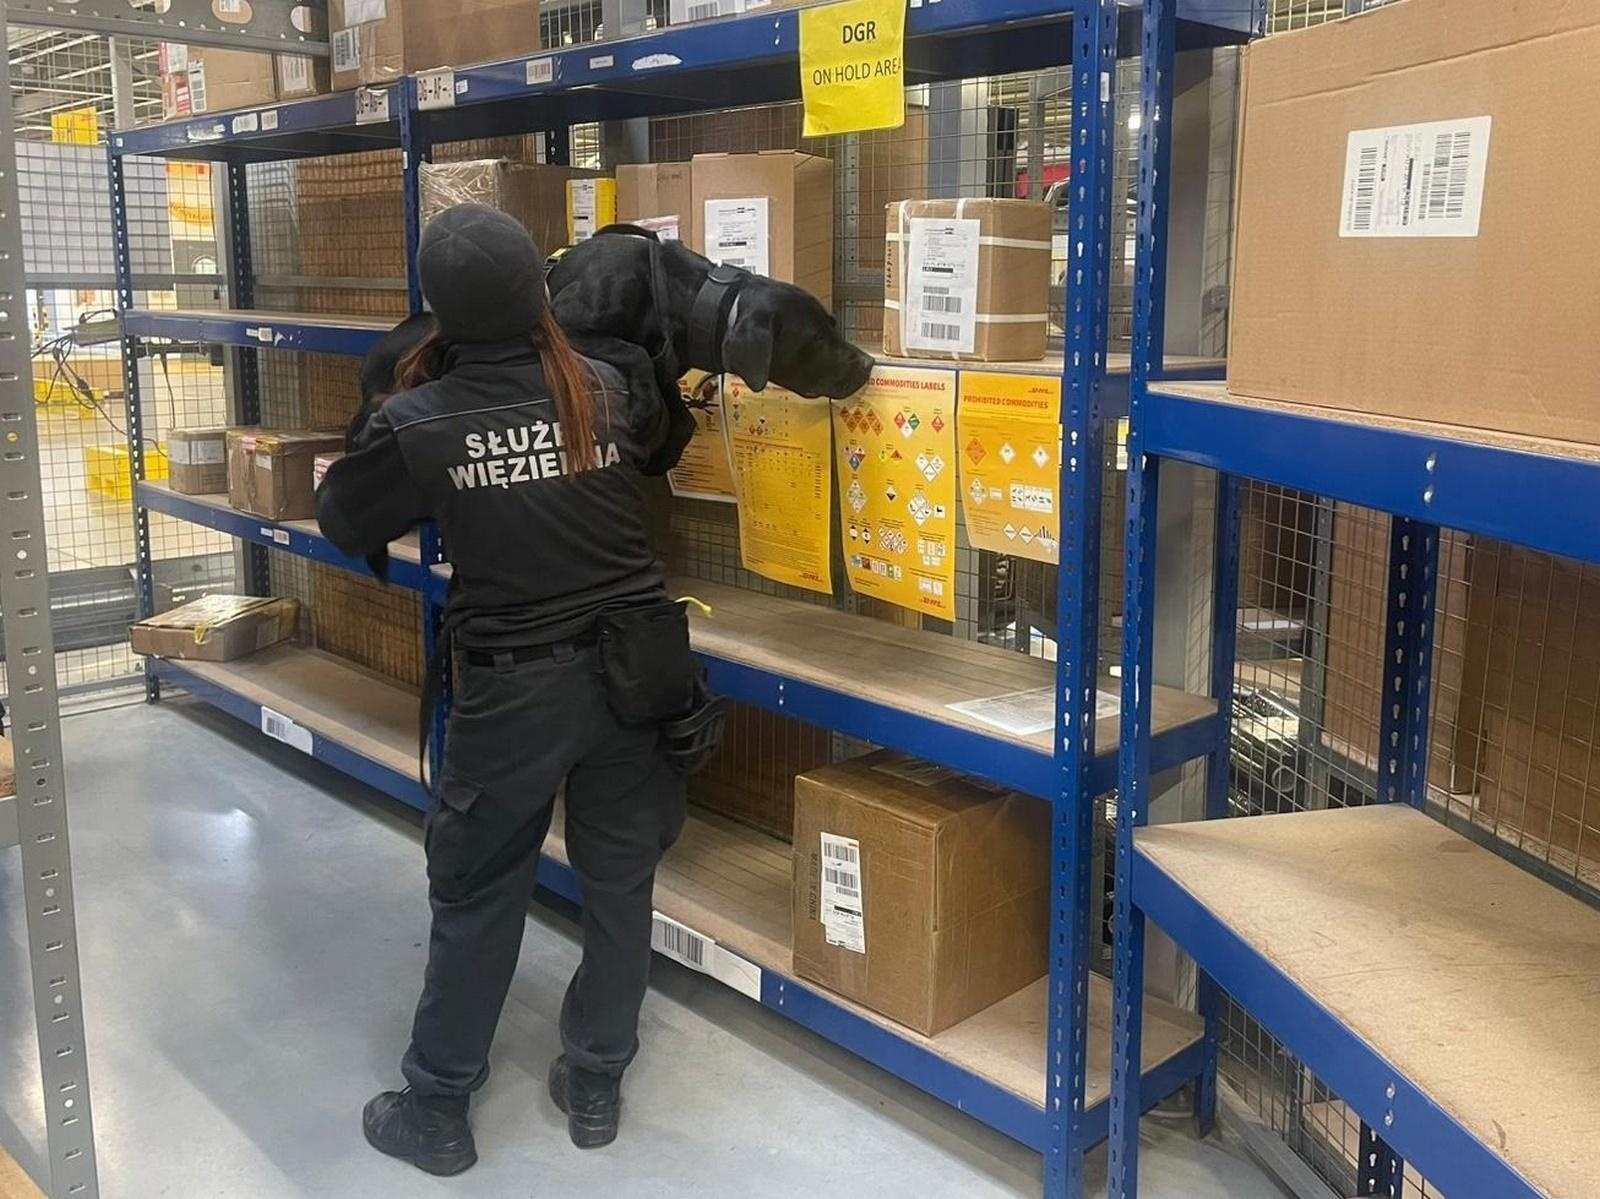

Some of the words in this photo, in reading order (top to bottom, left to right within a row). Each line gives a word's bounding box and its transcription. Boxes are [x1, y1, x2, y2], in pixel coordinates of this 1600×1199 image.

[842, 20, 877, 44] DGR
[813, 67, 832, 85] ON
[835, 62, 871, 83] HOLD
[875, 377, 919, 389] COMMODITIES
[920, 381, 945, 391] LABELS
[1001, 397, 1049, 409] COMMODITIES
